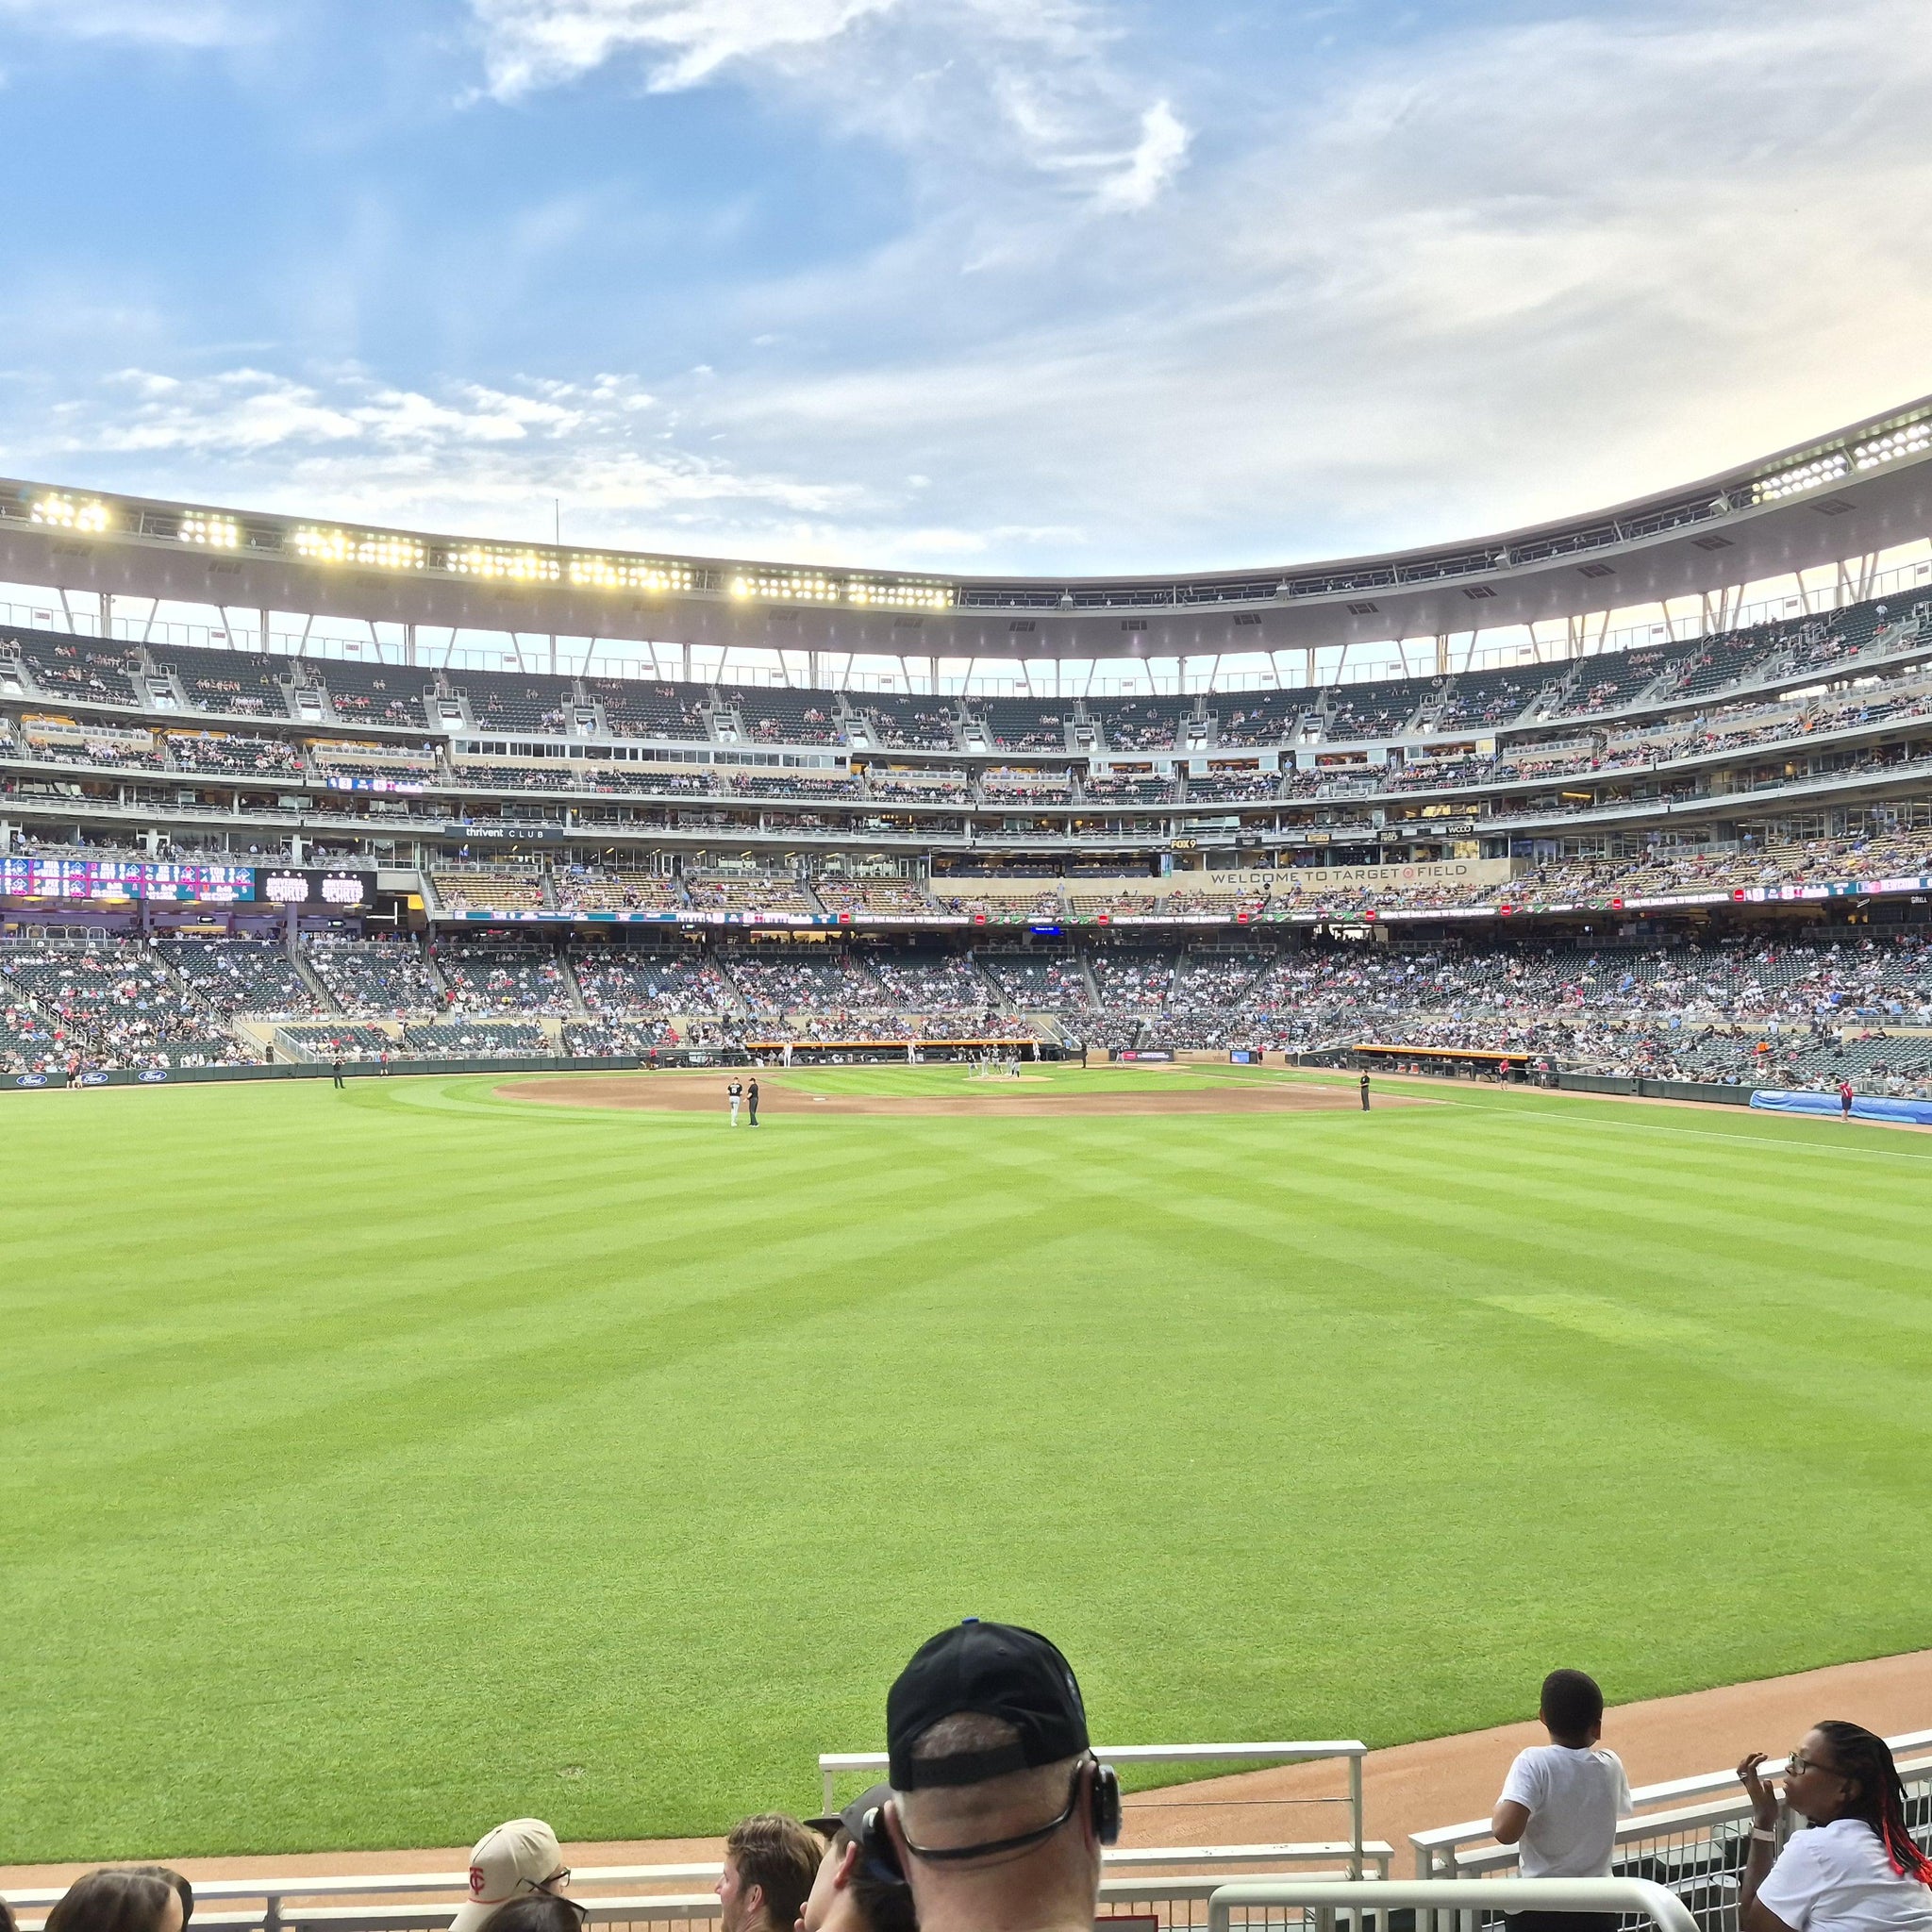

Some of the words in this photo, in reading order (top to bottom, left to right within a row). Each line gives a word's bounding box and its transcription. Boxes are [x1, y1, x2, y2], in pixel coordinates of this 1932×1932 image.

[466, 828, 503, 837] thrivent
[509, 830, 543, 838] CLUB
[1448, 825, 1471, 833] WCCO
[1171, 840, 1191, 849] FOX
[1190, 840, 1197, 848] 9
[1211, 872, 1299, 883] WELCOME
[1305, 871, 1327, 882] TO
[1332, 868, 1399, 880] TARGET
[1417, 865, 1467, 877] FIELD
[266, 878, 308, 886] UNIVERSAL
[322, 880, 362, 888] UNIVERSAL
[266, 886, 308, 897] SPORTS
[322, 887, 363, 898] SPORTS
[21, 1075, 44, 1085] Ford
[141, 1072, 164, 1081] Ford
